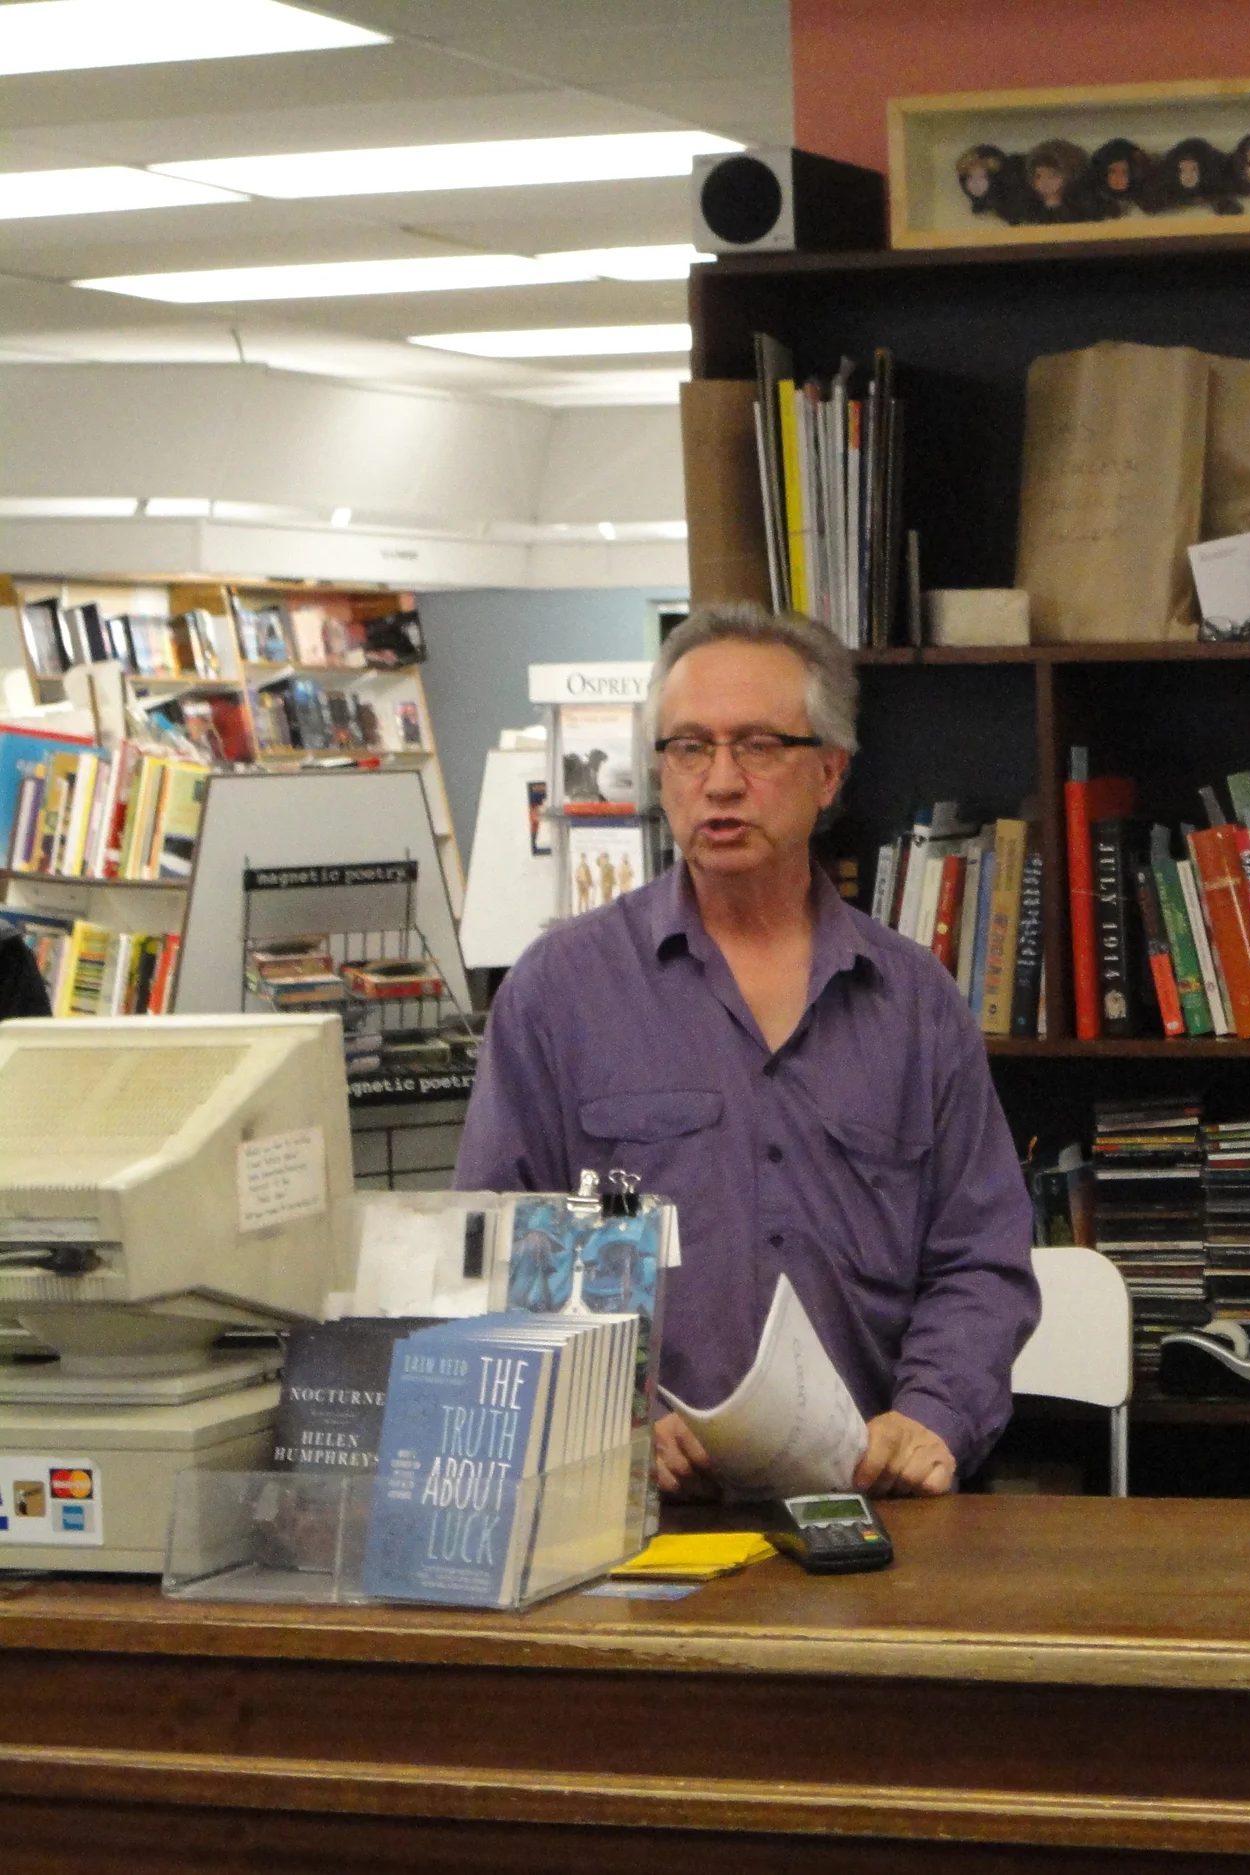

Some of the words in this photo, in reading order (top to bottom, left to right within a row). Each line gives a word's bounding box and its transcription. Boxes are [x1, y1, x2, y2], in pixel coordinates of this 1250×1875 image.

[256, 869, 340, 888] magnetic
[345, 866, 406, 885] poetry
[1098, 842, 1117, 906] JULY
[1102, 922, 1120, 980] 1914
[349, 1078, 416, 1098] gnetic
[420, 1073, 476, 1094] poetr
[290, 1387, 386, 1407] NOCTURNE
[479, 1355, 529, 1410] THE
[302, 1430, 359, 1448] HELEN
[440, 1404, 520, 1461] TRUTH
[422, 1456, 512, 1511] ABOUT
[427, 1511, 501, 1566] LUCK
